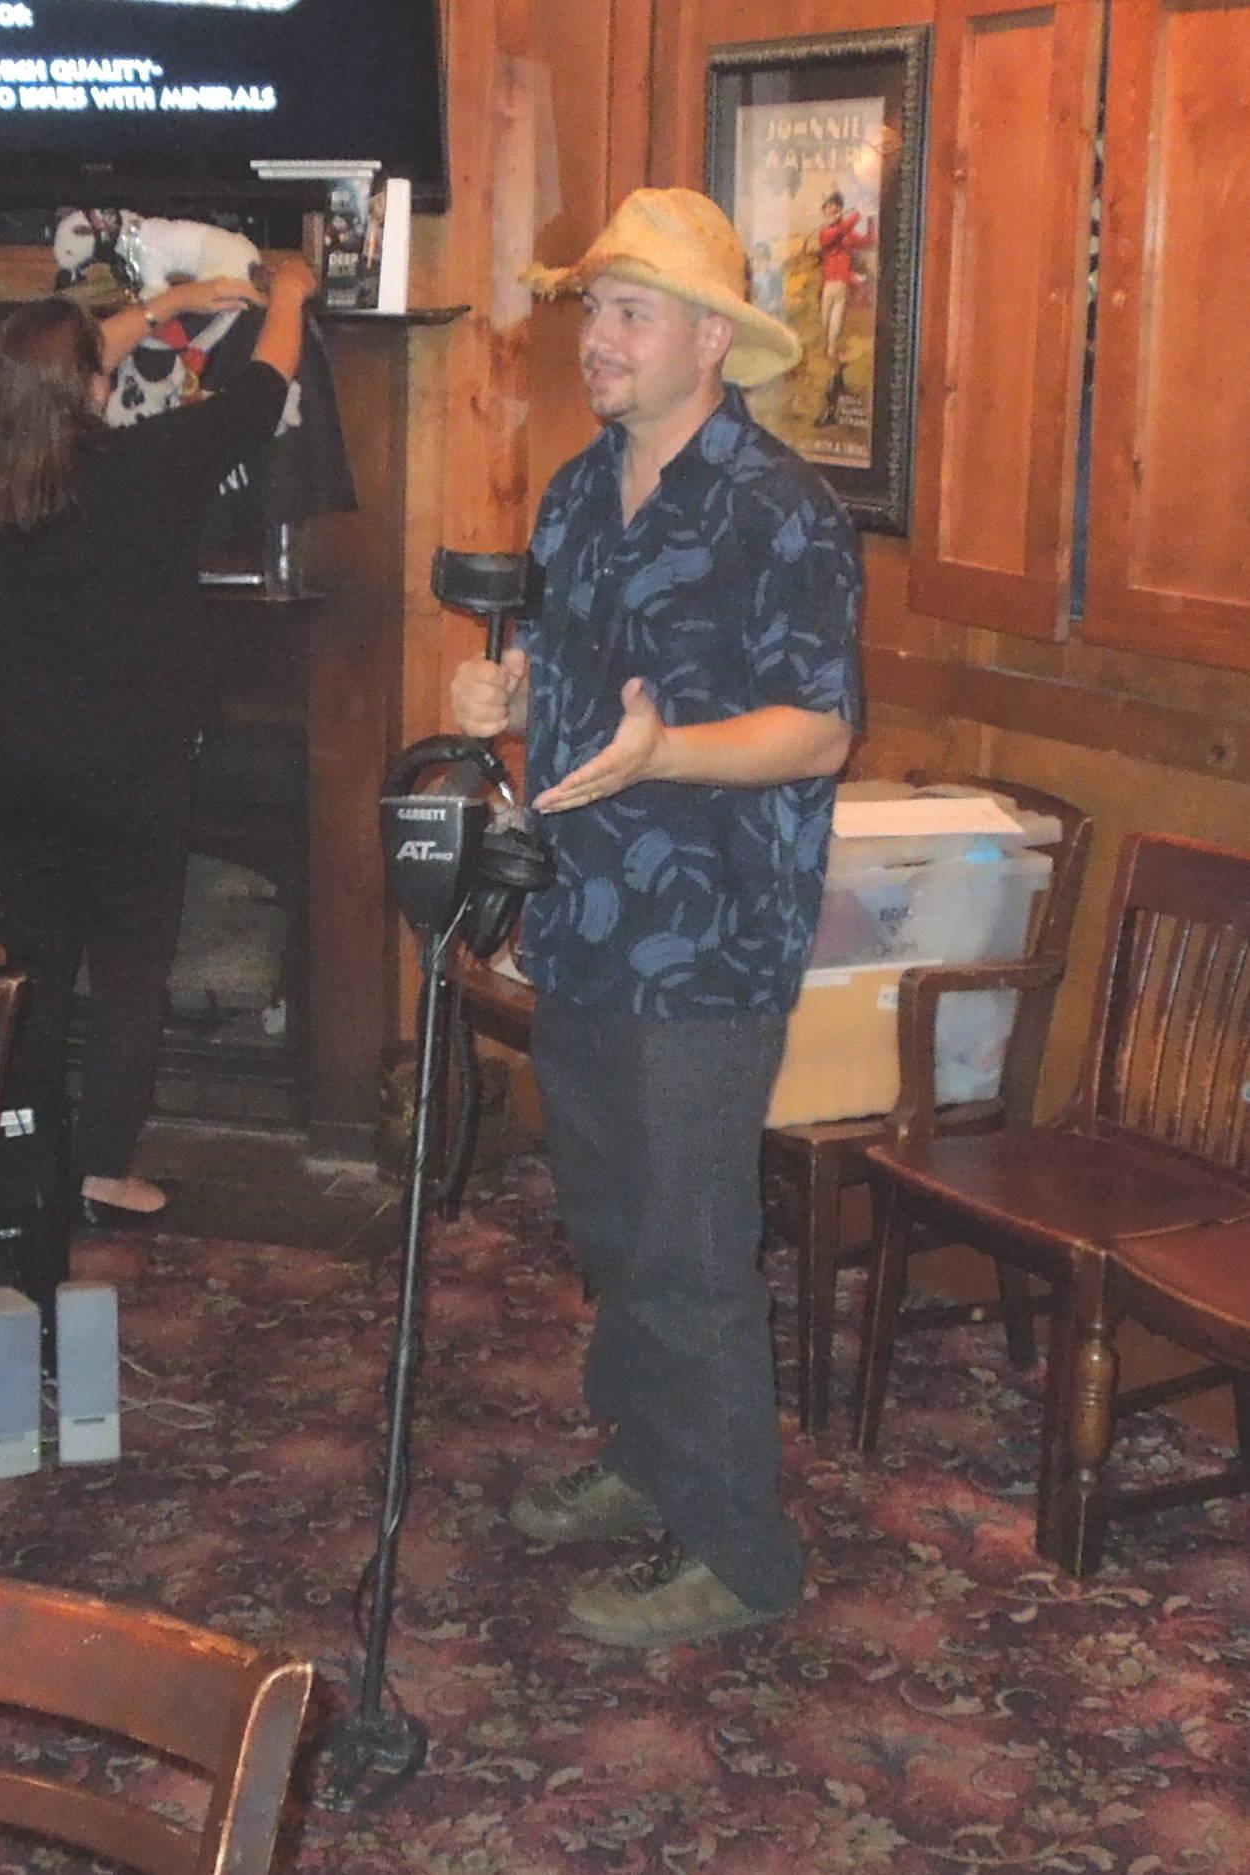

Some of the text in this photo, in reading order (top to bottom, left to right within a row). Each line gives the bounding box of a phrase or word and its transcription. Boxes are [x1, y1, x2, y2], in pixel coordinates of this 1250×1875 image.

[20, 86, 88, 110] ISSUES
[91, 86, 156, 110] WITH
[161, 86, 276, 110] MINERALS
[396, 807, 447, 821] GARRETT
